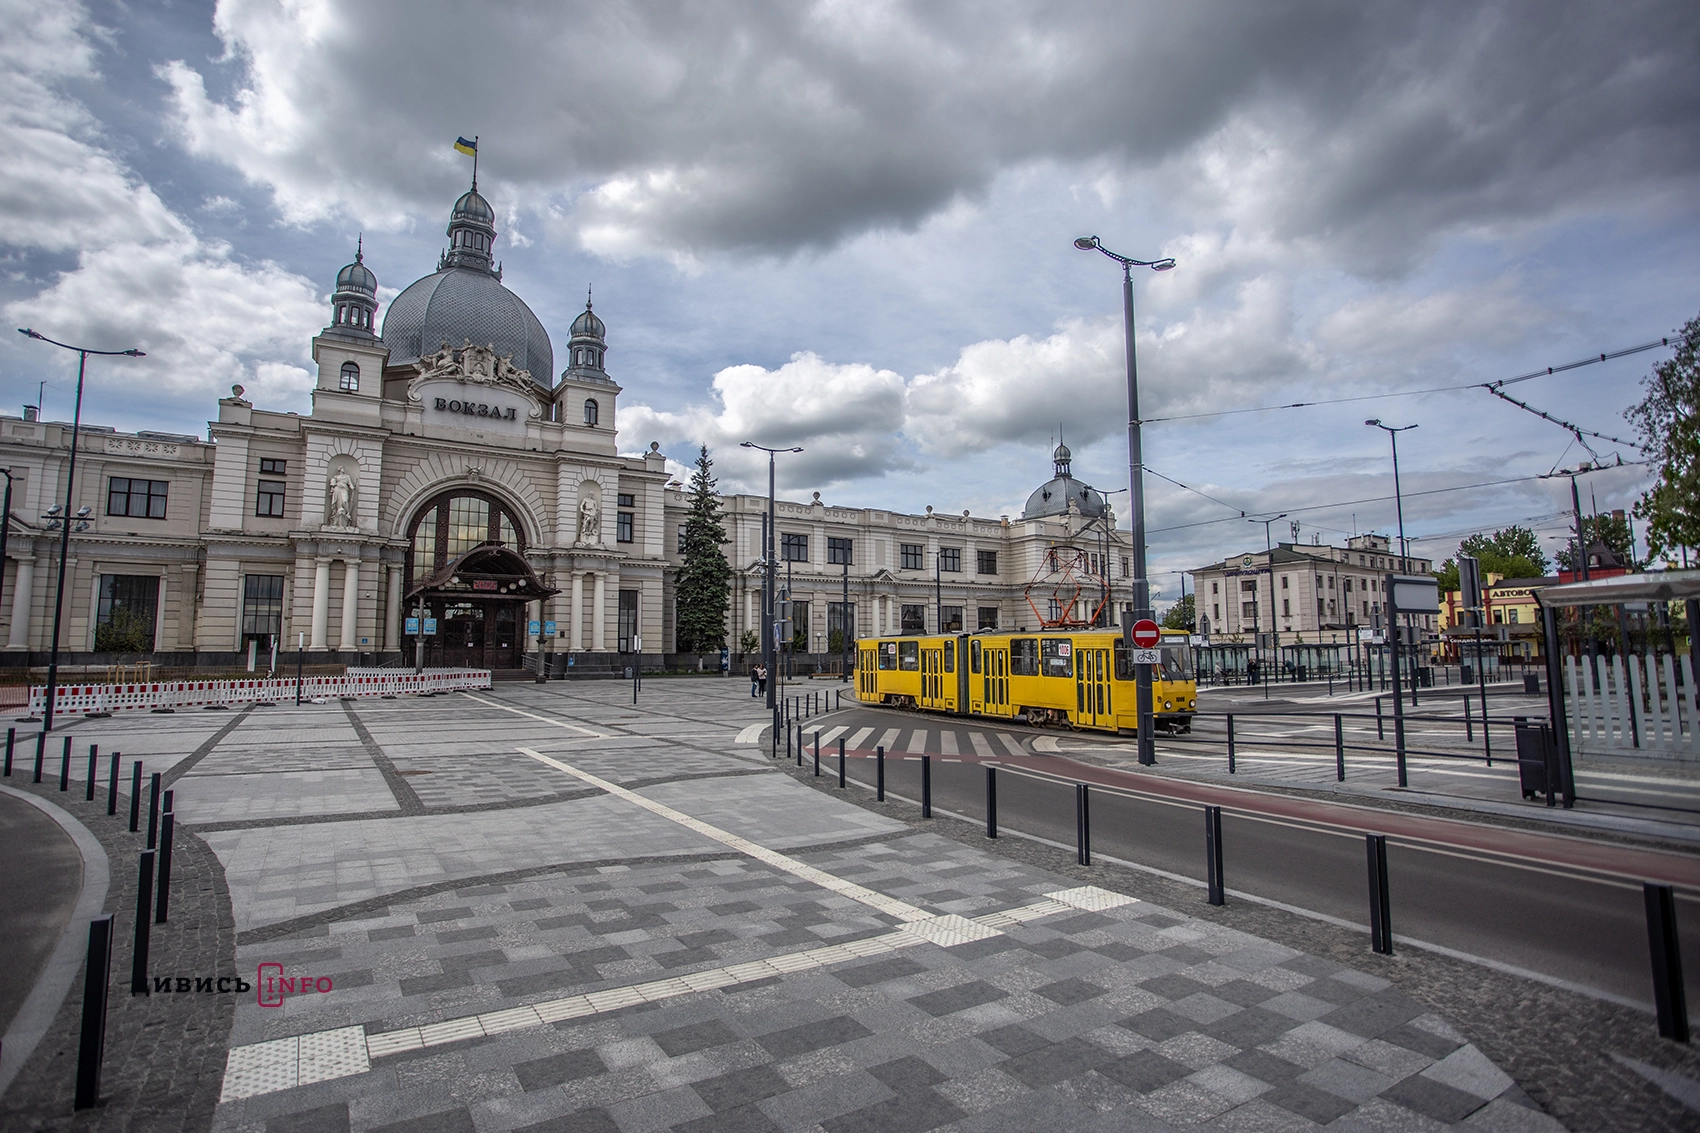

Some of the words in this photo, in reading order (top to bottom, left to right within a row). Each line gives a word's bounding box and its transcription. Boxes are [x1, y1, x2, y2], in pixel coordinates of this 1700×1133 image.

[434, 397, 517, 420] ВОКЗАЛ
[1492, 589, 1531, 598] АВТОВО
[1059, 645, 1070, 656] 1006
